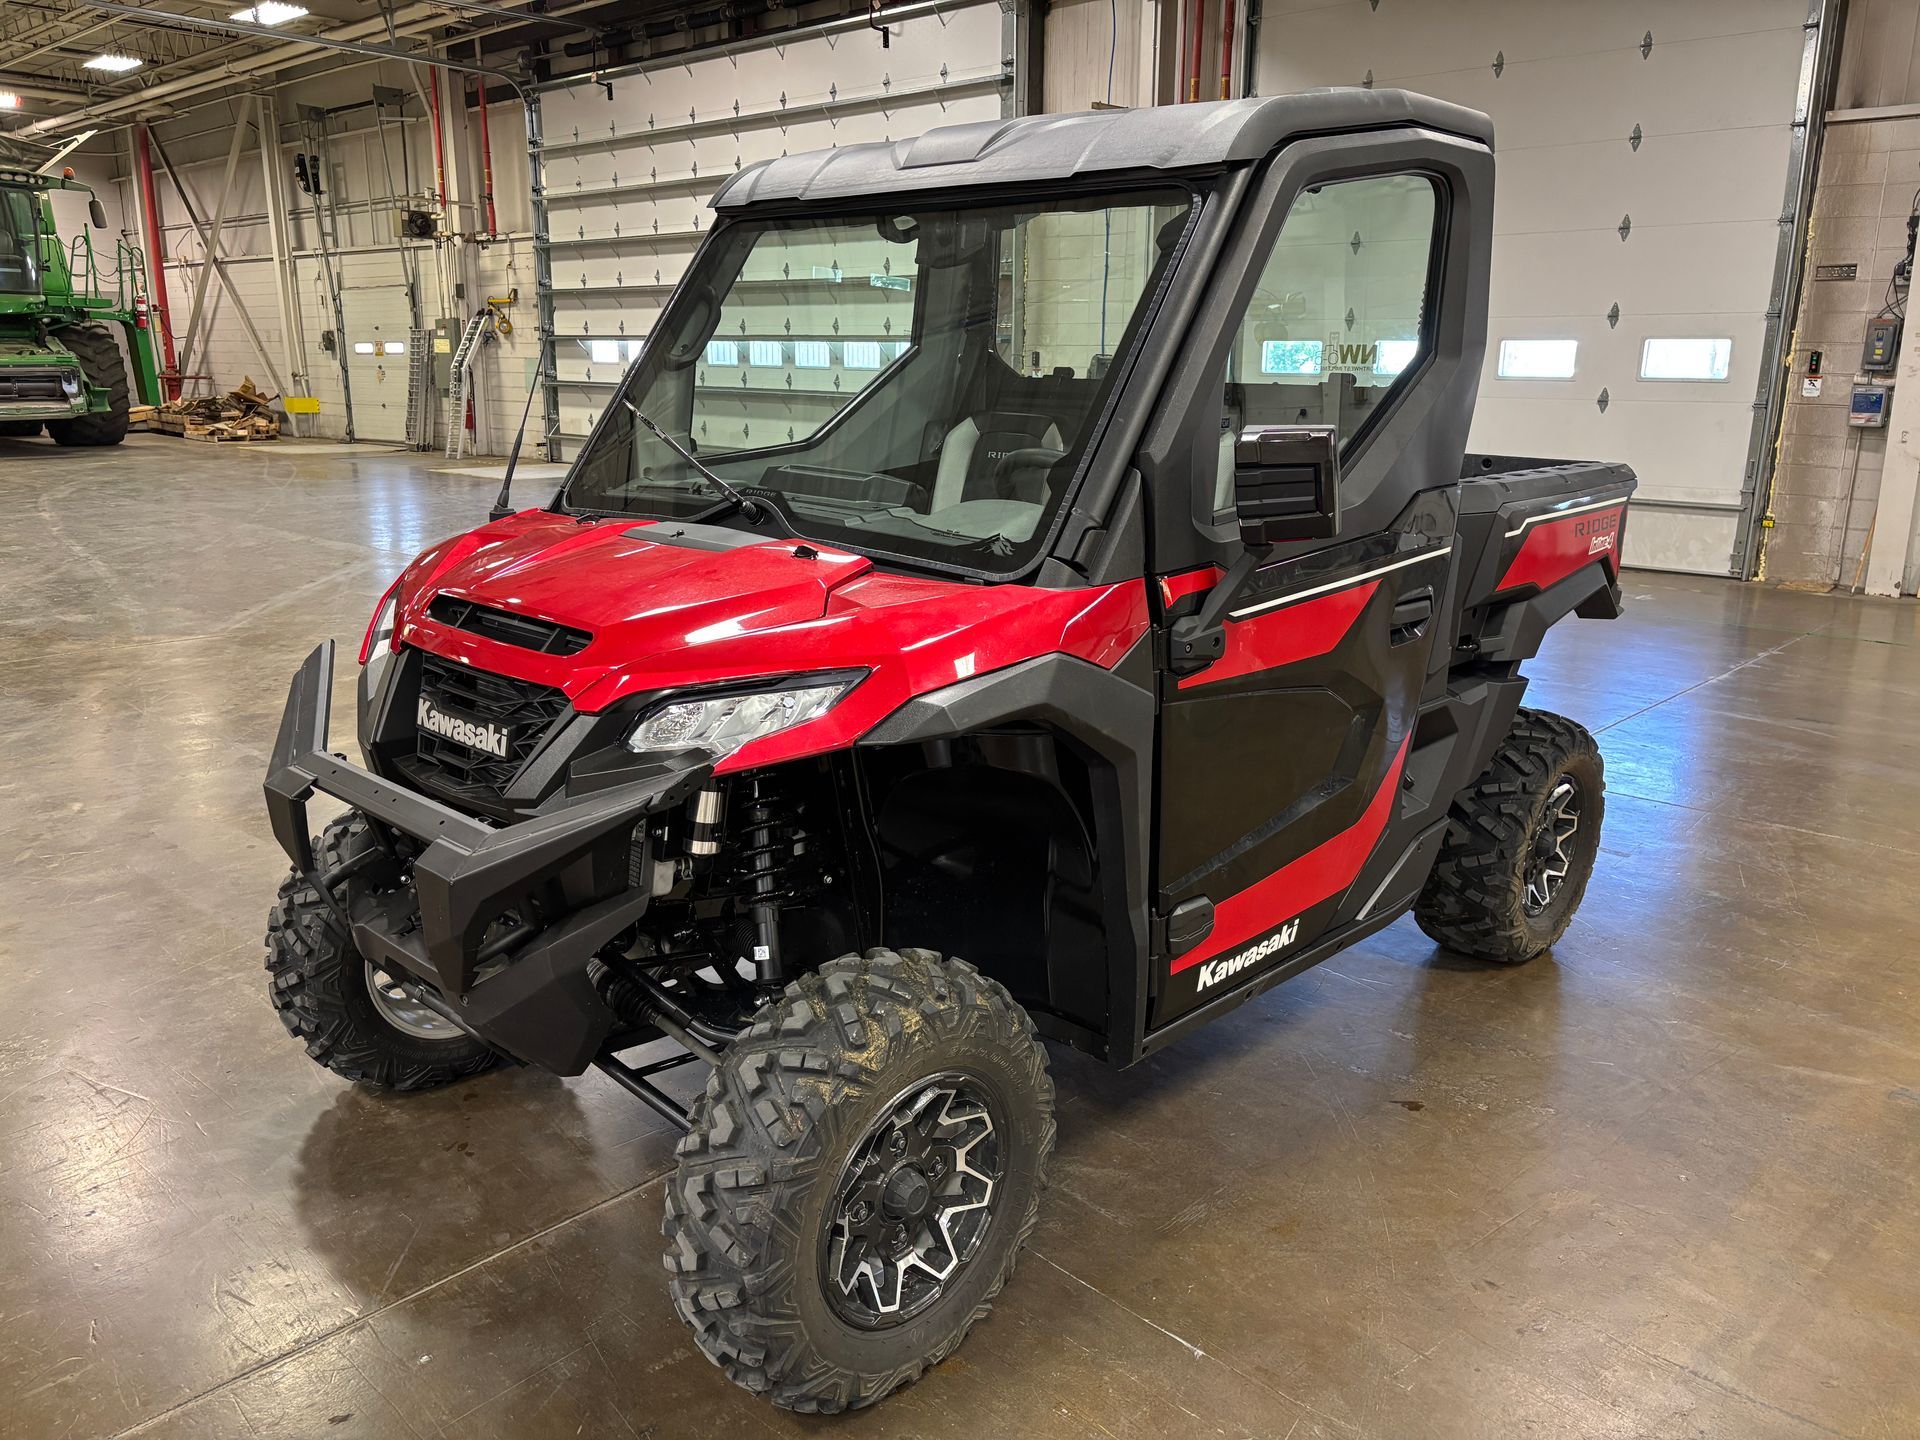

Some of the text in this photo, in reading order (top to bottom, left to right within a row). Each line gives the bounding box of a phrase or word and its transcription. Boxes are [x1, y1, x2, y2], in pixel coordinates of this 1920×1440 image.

[1574, 513, 1617, 538] RIDGE
[417, 698, 508, 757] Kawasaki
[1196, 918, 1300, 993] Kawasaki
